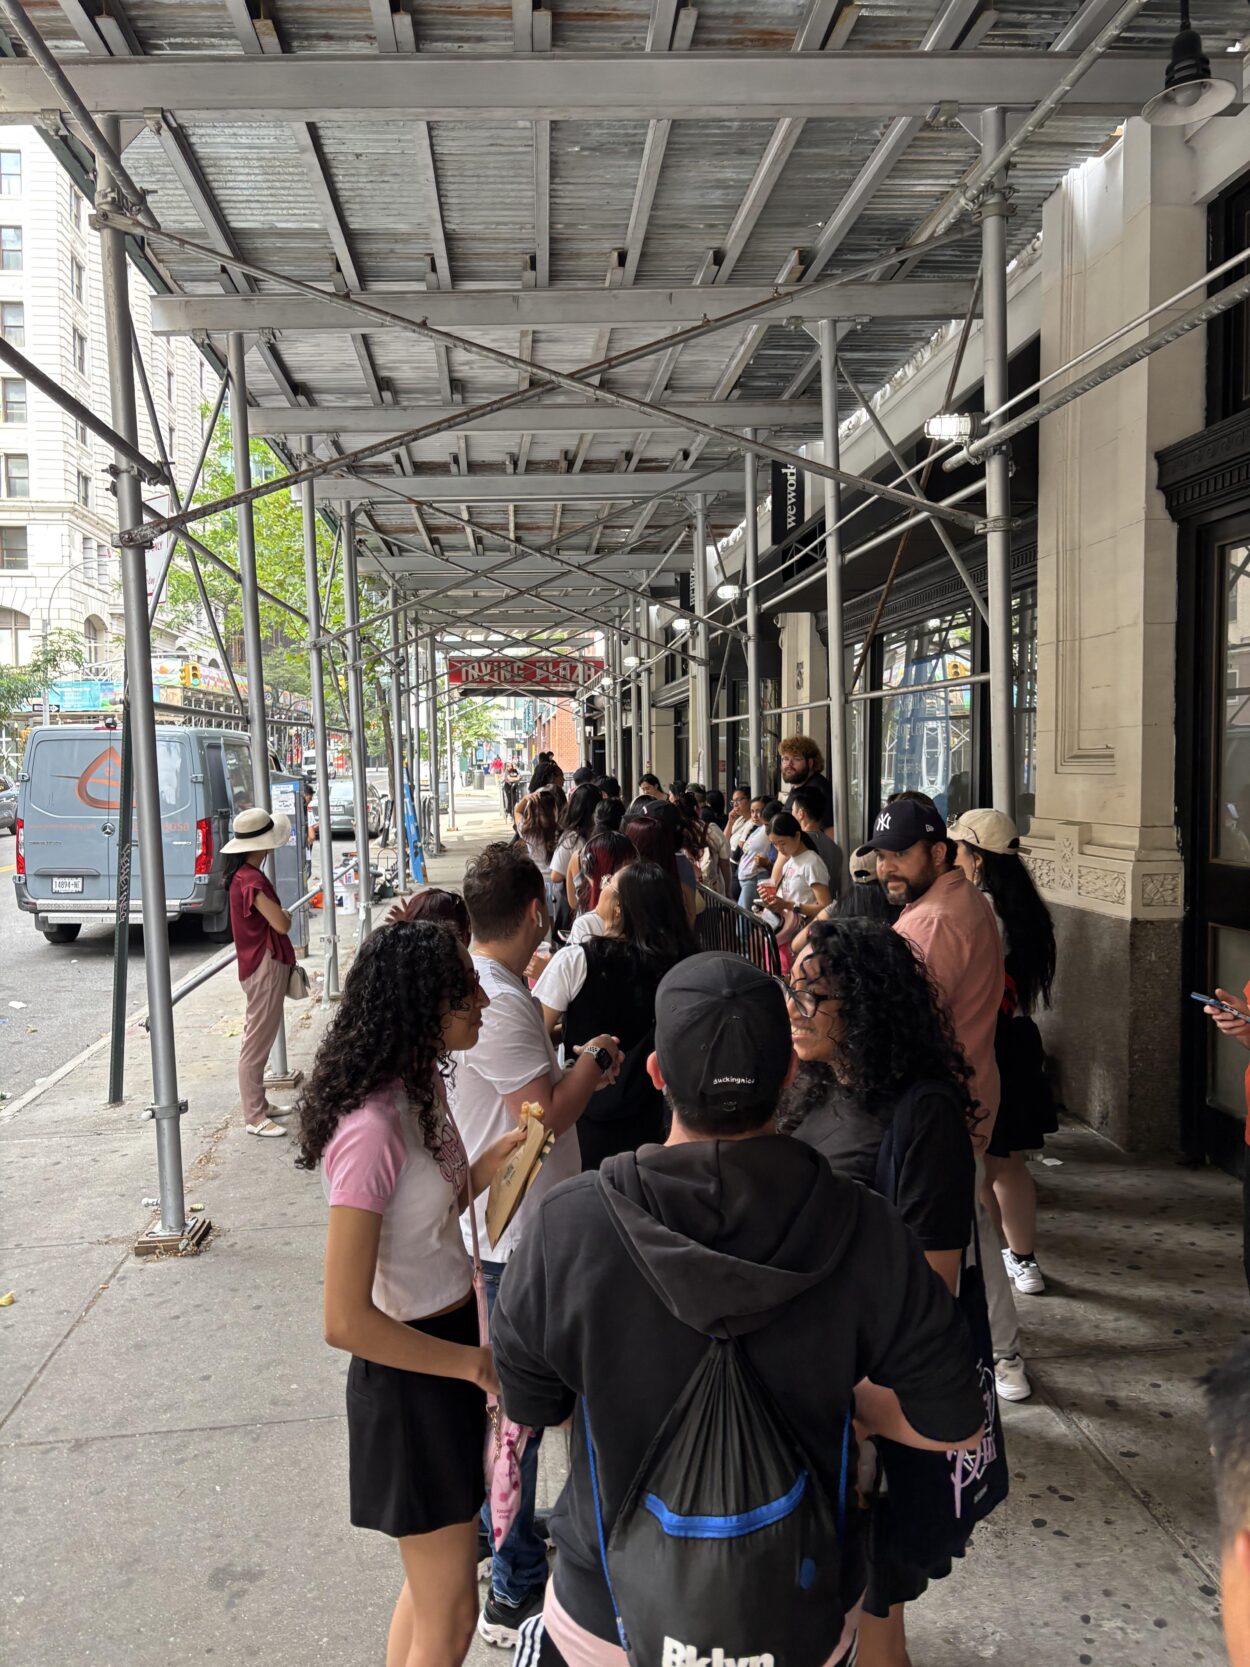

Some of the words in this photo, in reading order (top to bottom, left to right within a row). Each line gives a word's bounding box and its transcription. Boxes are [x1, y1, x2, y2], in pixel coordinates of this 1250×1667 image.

[781, 464, 797, 530] wework
[535, 661, 595, 682] PLAZA
[876, 812, 892, 831] NY
